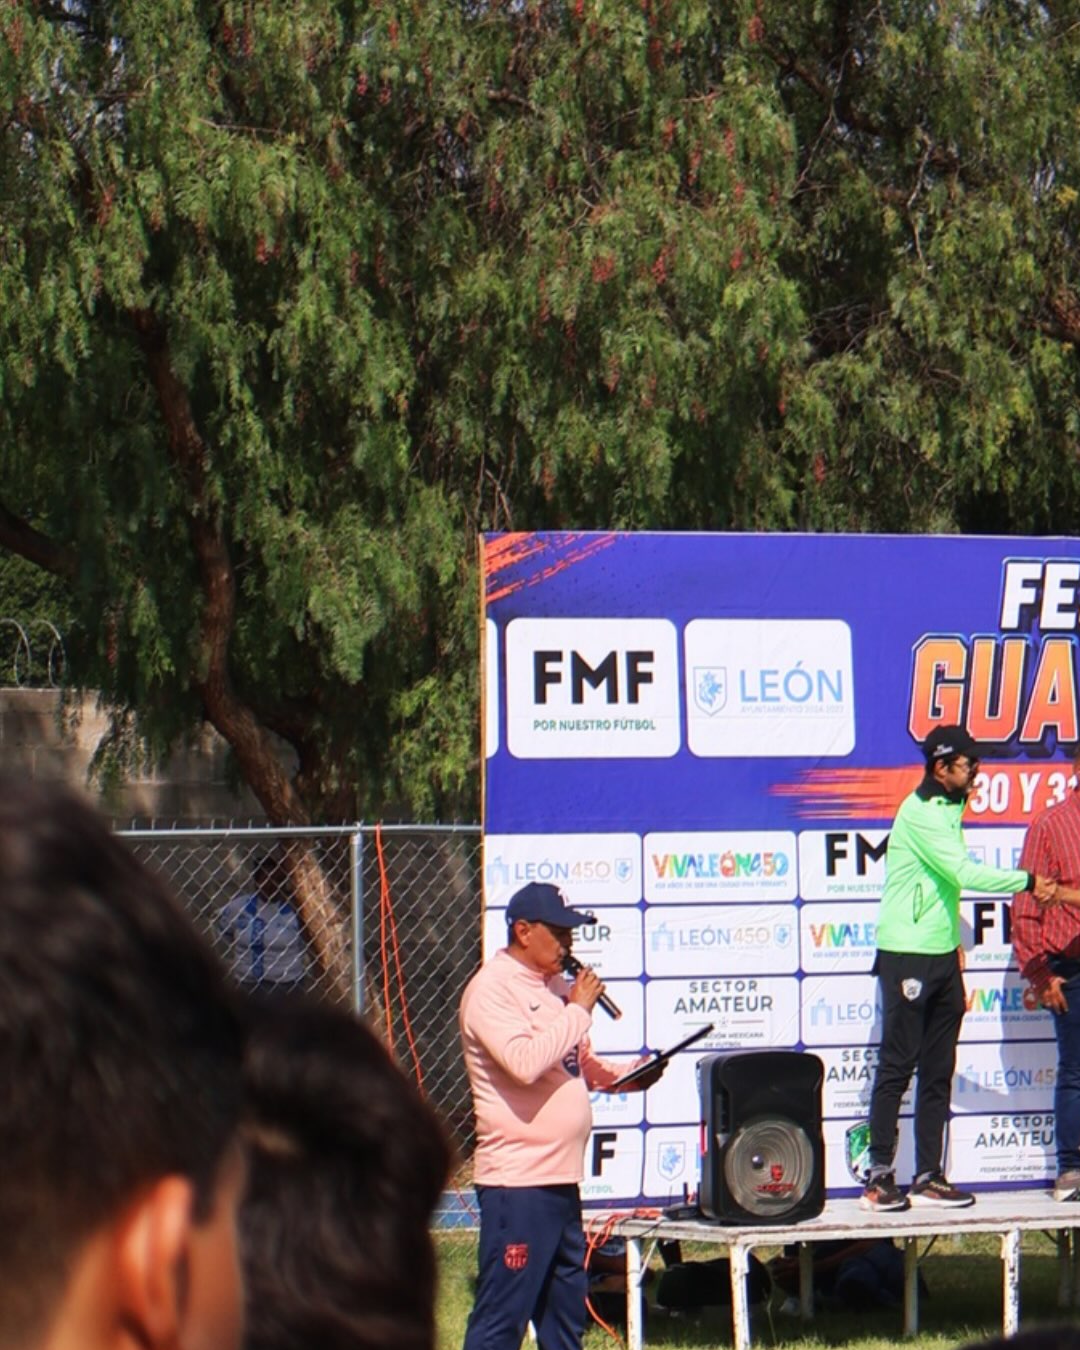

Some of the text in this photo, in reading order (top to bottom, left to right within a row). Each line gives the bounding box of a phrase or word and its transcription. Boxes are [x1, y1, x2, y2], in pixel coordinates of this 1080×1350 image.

[533, 650, 654, 704] FMF
[740, 661, 843, 702] LEÓN
[533, 717, 656, 731] POR NUESTRO FÚTBOL
[969, 772, 1010, 813] 30
[1020, 772, 1041, 813] Y
[825, 833, 891, 876] FM
[689, 980, 758, 993] SECTOR
[674, 995, 773, 1015] AMATEUR
[974, 1131, 1055, 1149] AMATEU
